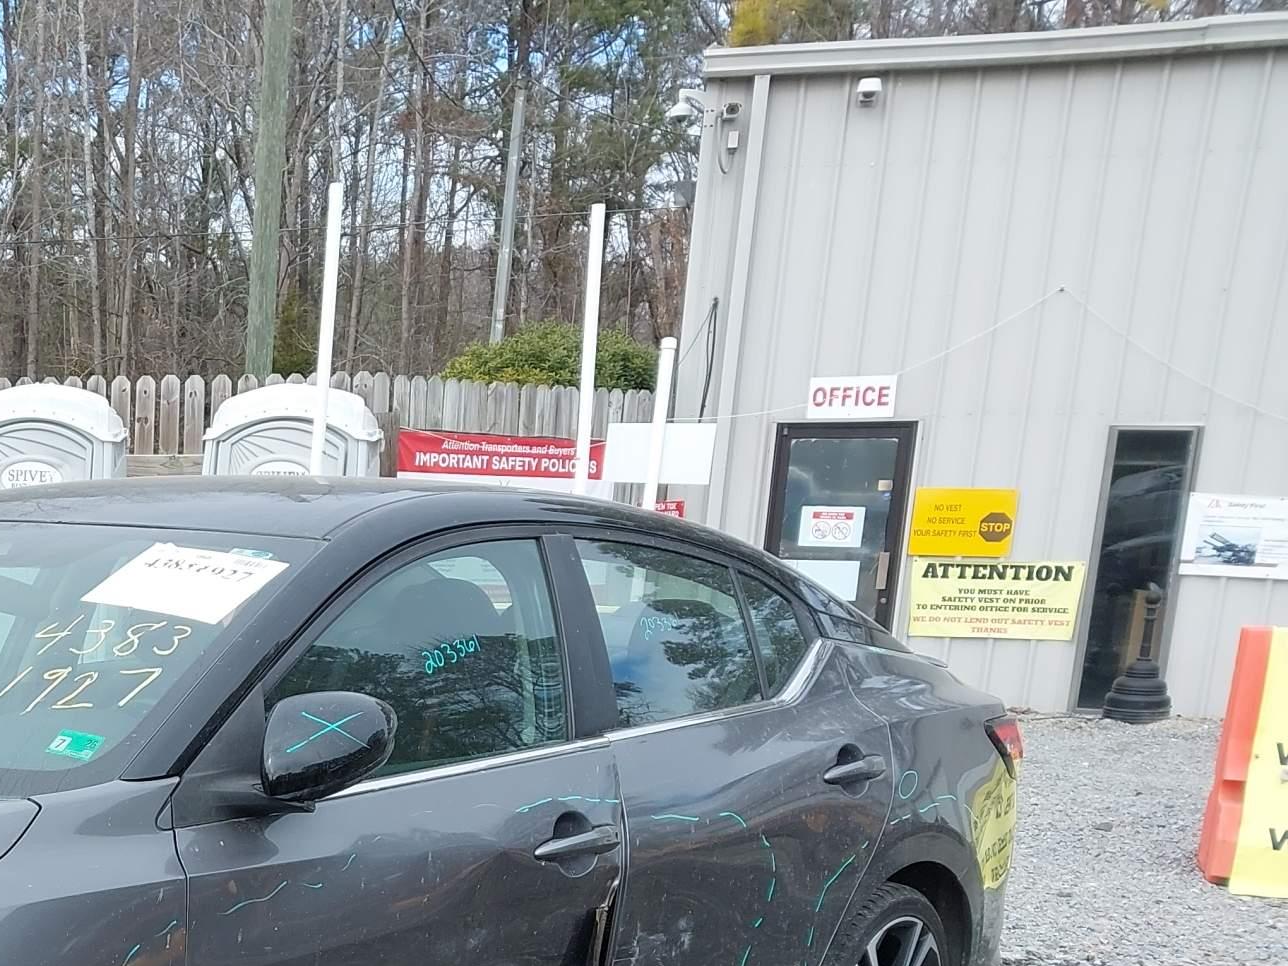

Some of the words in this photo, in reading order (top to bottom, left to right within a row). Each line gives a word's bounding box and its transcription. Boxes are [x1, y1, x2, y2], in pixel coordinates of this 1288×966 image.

[812, 385, 891, 407] OFFICE
[441, 440, 480, 451] Attention
[481, 442, 530, 454] Transporters
[531, 445, 548, 454] and
[548, 446, 576, 456] Buyers
[415, 452, 490, 469] IMPORTANT
[492, 456, 539, 471] SAFETY
[541, 458, 597, 474] POLICS
[933, 504, 945, 512] NO
[946, 504, 962, 512] VEST
[926, 517, 938, 525] NO
[938, 517, 966, 525] SERVICE
[980, 523, 1011, 533] STOP
[913, 529, 931, 537] YOUR
[931, 529, 957, 537] SAFETY
[958, 530, 977, 538] FIRST
[922, 562, 1075, 582] ATTENTION
[978, 588, 1004, 596] MUST
[977, 596, 1001, 604] VEST
[1010, 618, 1046, 626] SAFETY
[1048, 619, 1071, 627] VEST
[971, 626, 1008, 634] THANKS
[34, 614, 192, 657] 4383
[54, 738, 66, 749] 7
